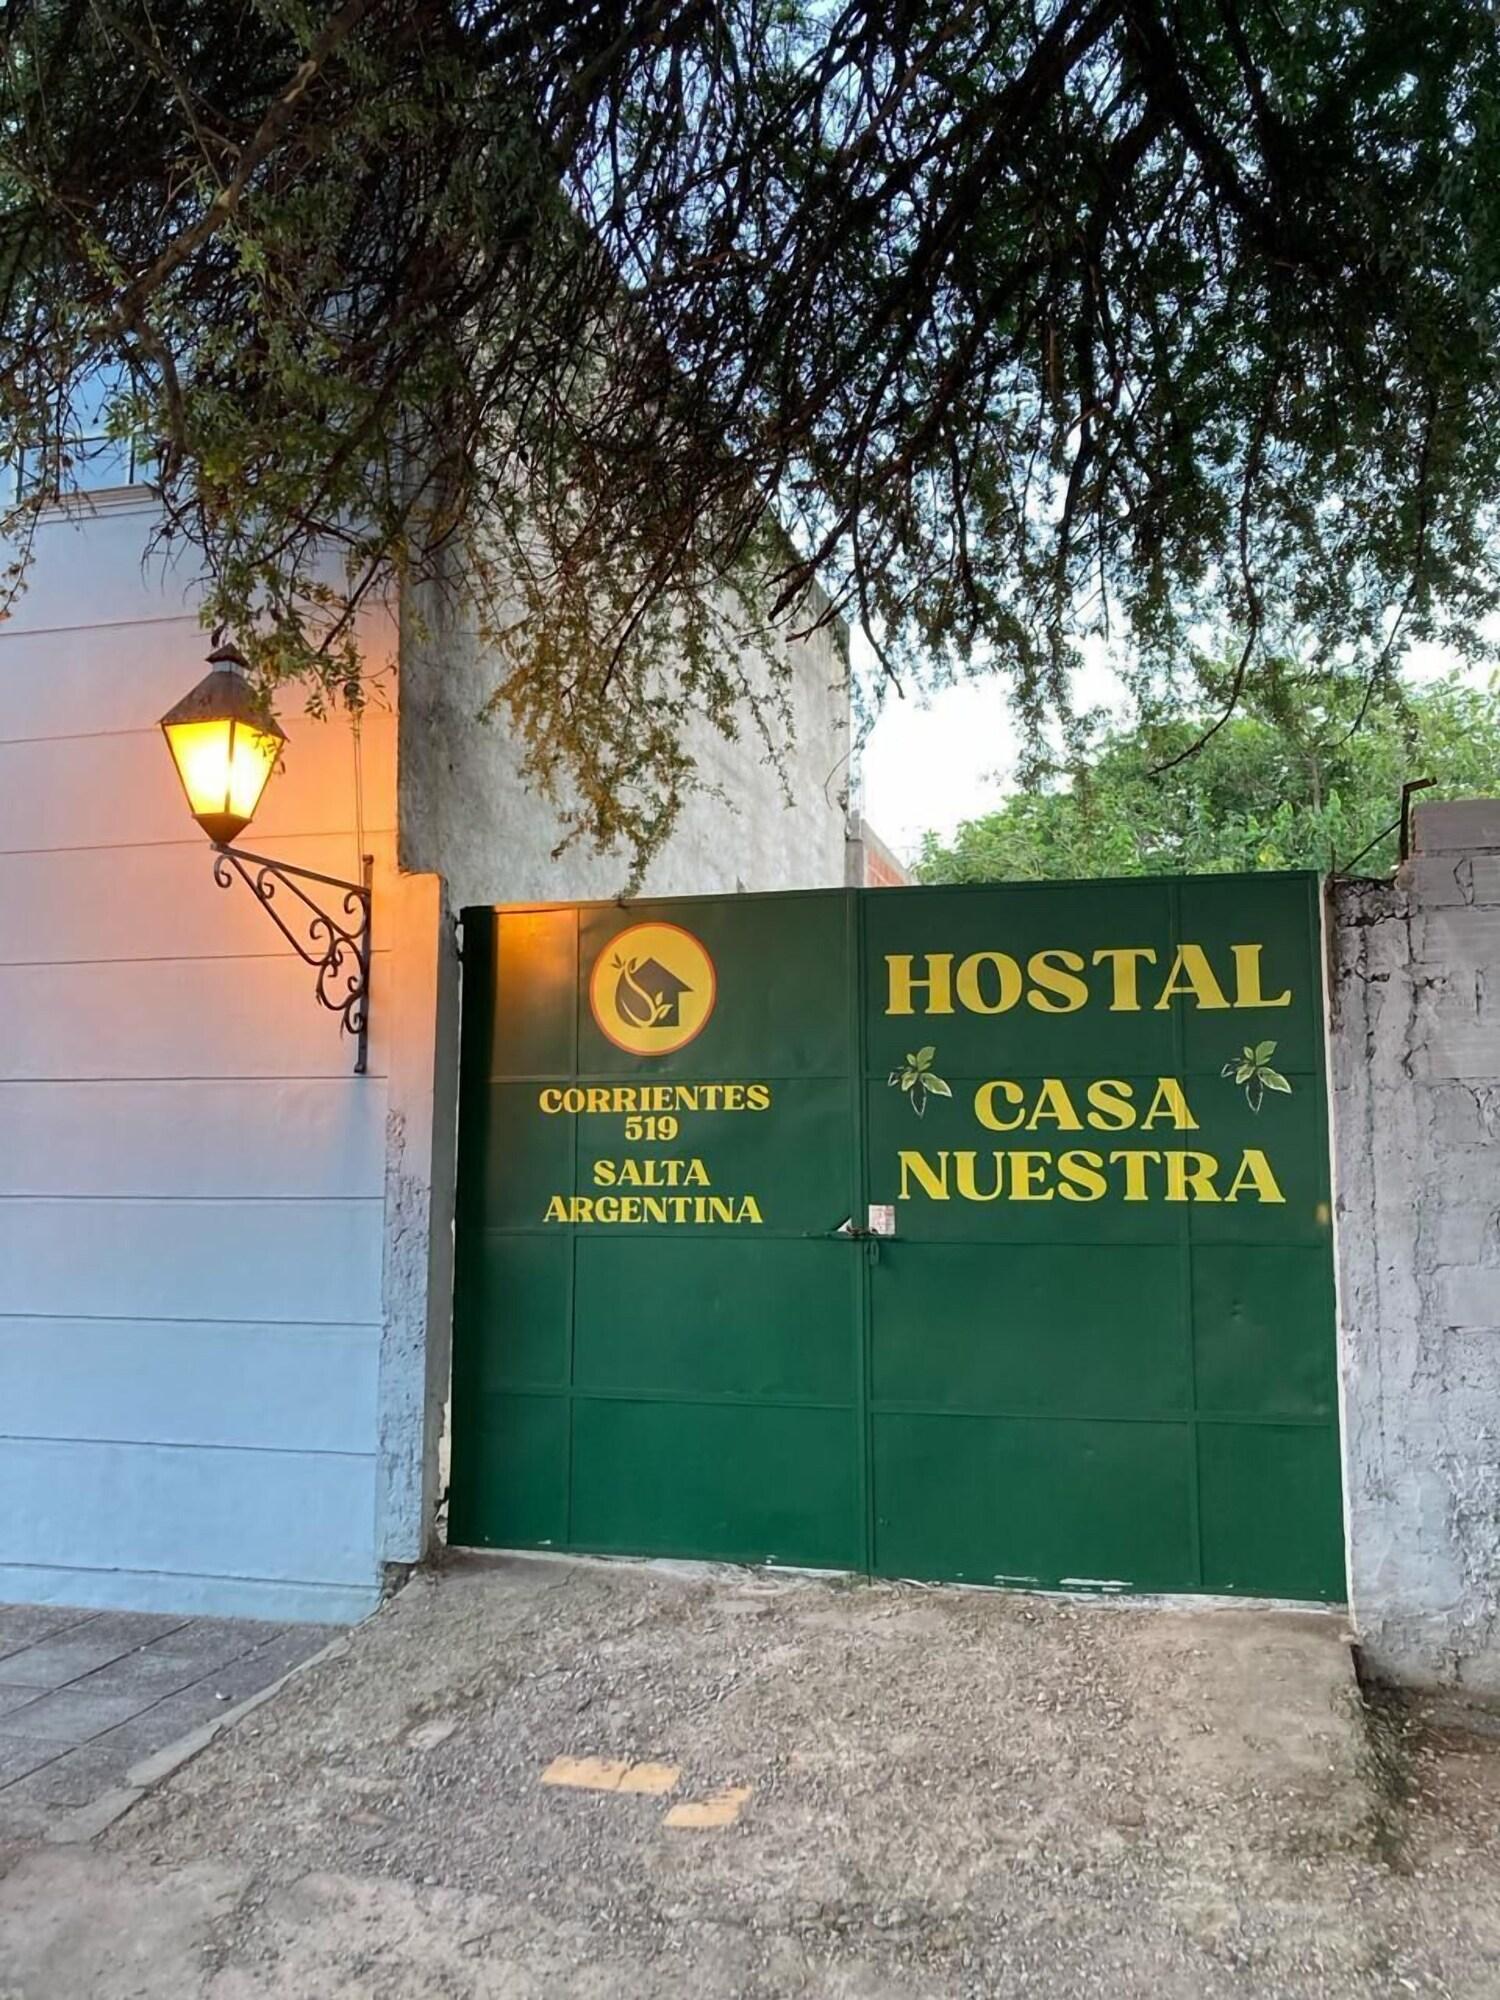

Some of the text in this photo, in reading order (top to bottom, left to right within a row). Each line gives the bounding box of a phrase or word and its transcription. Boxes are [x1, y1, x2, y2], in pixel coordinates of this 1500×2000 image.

[884, 944, 1292, 1016] HOSTAL
[538, 1085, 771, 1113] CORRIENTES
[974, 1077, 1200, 1132] CASA
[624, 1115, 679, 1141] 519
[593, 1158, 710, 1186] SALTA
[898, 1149, 1286, 1203] NUESTRA
[543, 1195, 763, 1224] ARGENTINA
